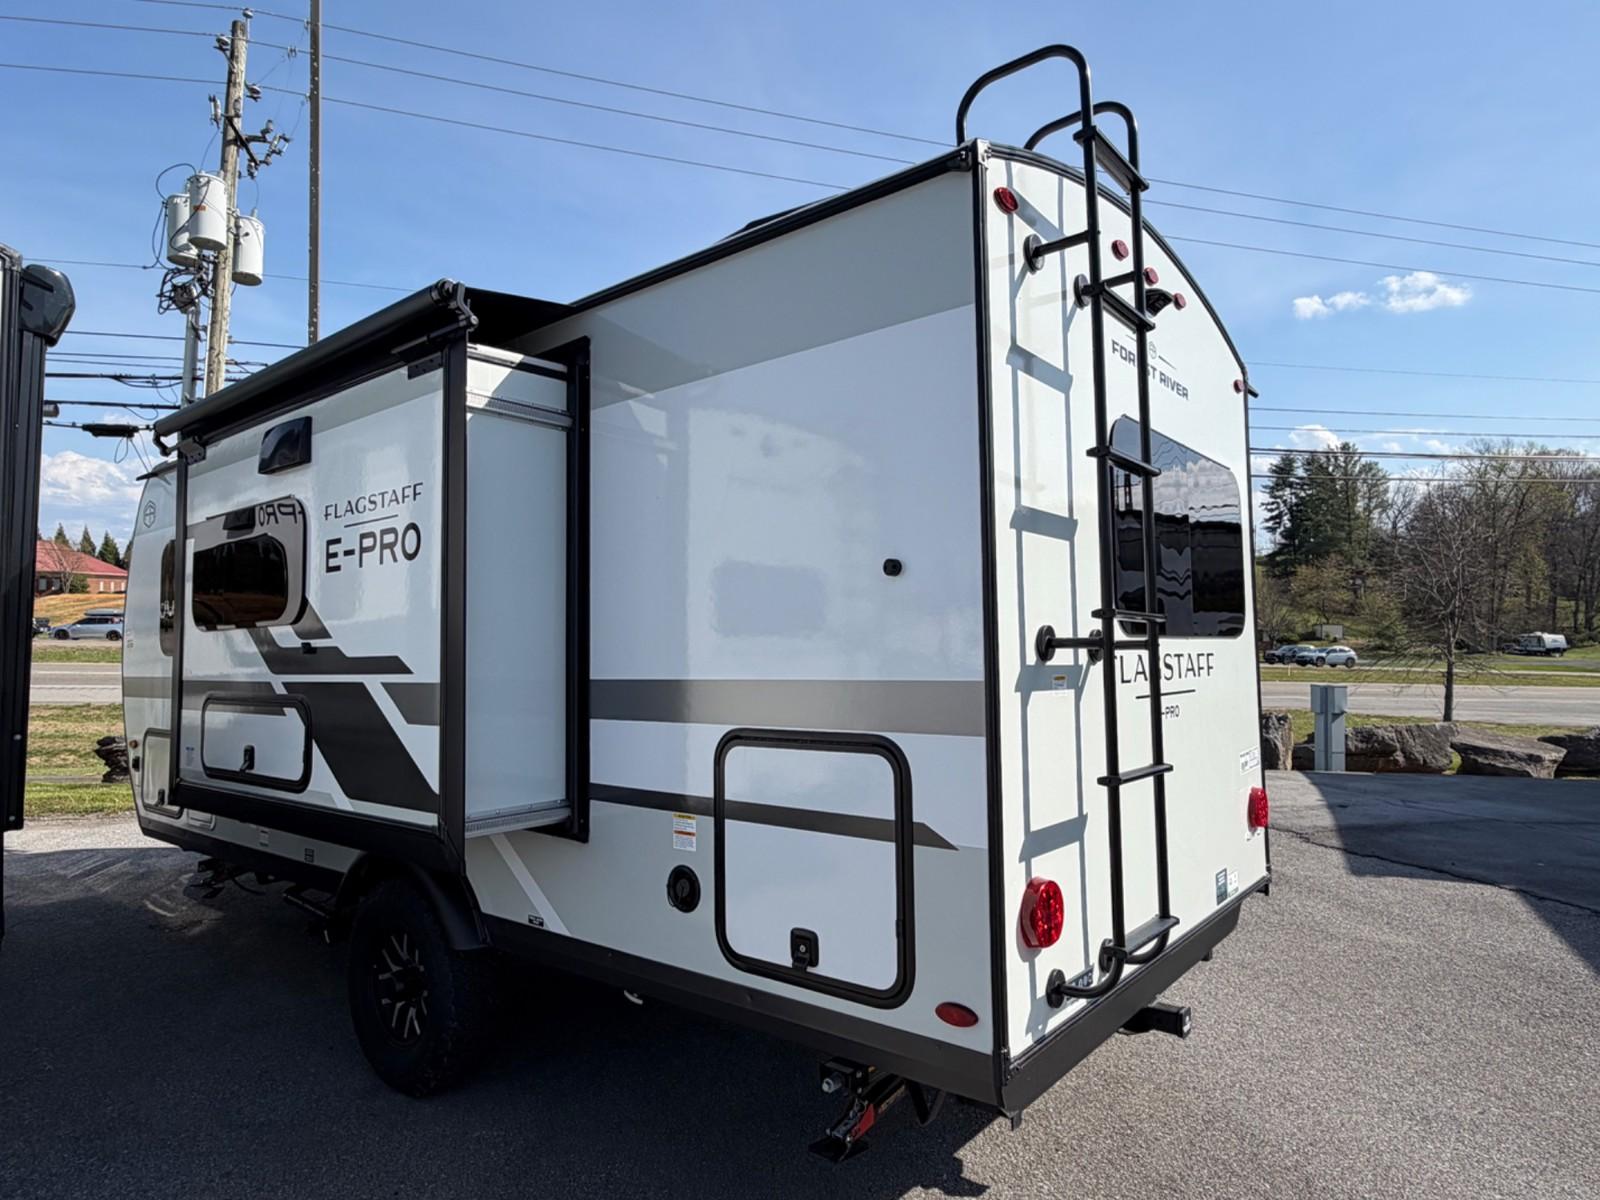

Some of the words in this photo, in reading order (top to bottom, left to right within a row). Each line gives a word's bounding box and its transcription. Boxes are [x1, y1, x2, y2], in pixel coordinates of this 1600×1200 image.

[1111, 339, 1157, 380] FORT
[1159, 370, 1189, 401] RIVER
[323, 482, 423, 521] FLAGSTAFF
[325, 522, 422, 574] E-PRO
[1115, 652, 1214, 684] LASTAFF
[1161, 704, 1180, 719] -PRO
